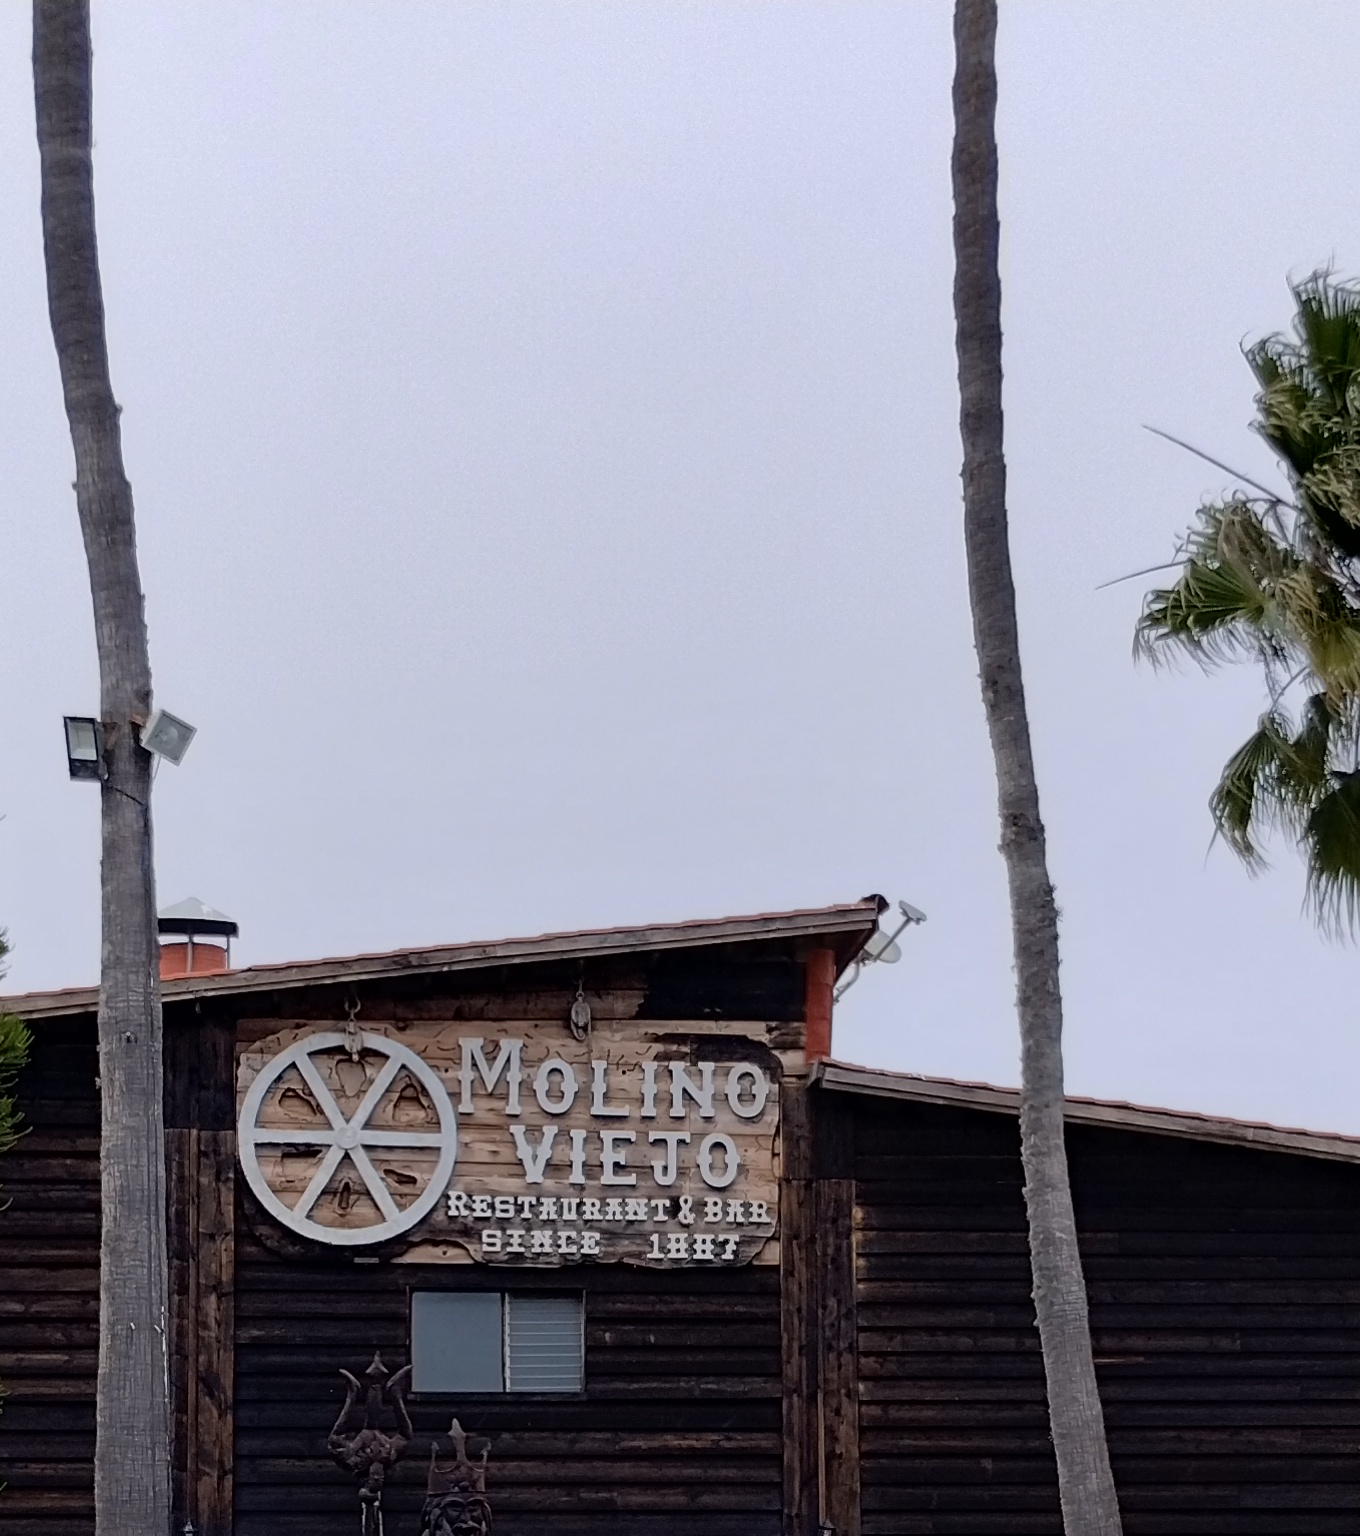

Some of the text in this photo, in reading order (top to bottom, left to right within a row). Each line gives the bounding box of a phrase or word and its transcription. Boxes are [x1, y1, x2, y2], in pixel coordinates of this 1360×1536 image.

[458, 1037, 769, 1118] MOLINO
[509, 1125, 740, 1188] VIEJO
[447, 1190, 771, 1225] RESTAURANT & BAR
[481, 1230, 740, 1260] SINCE 1887
